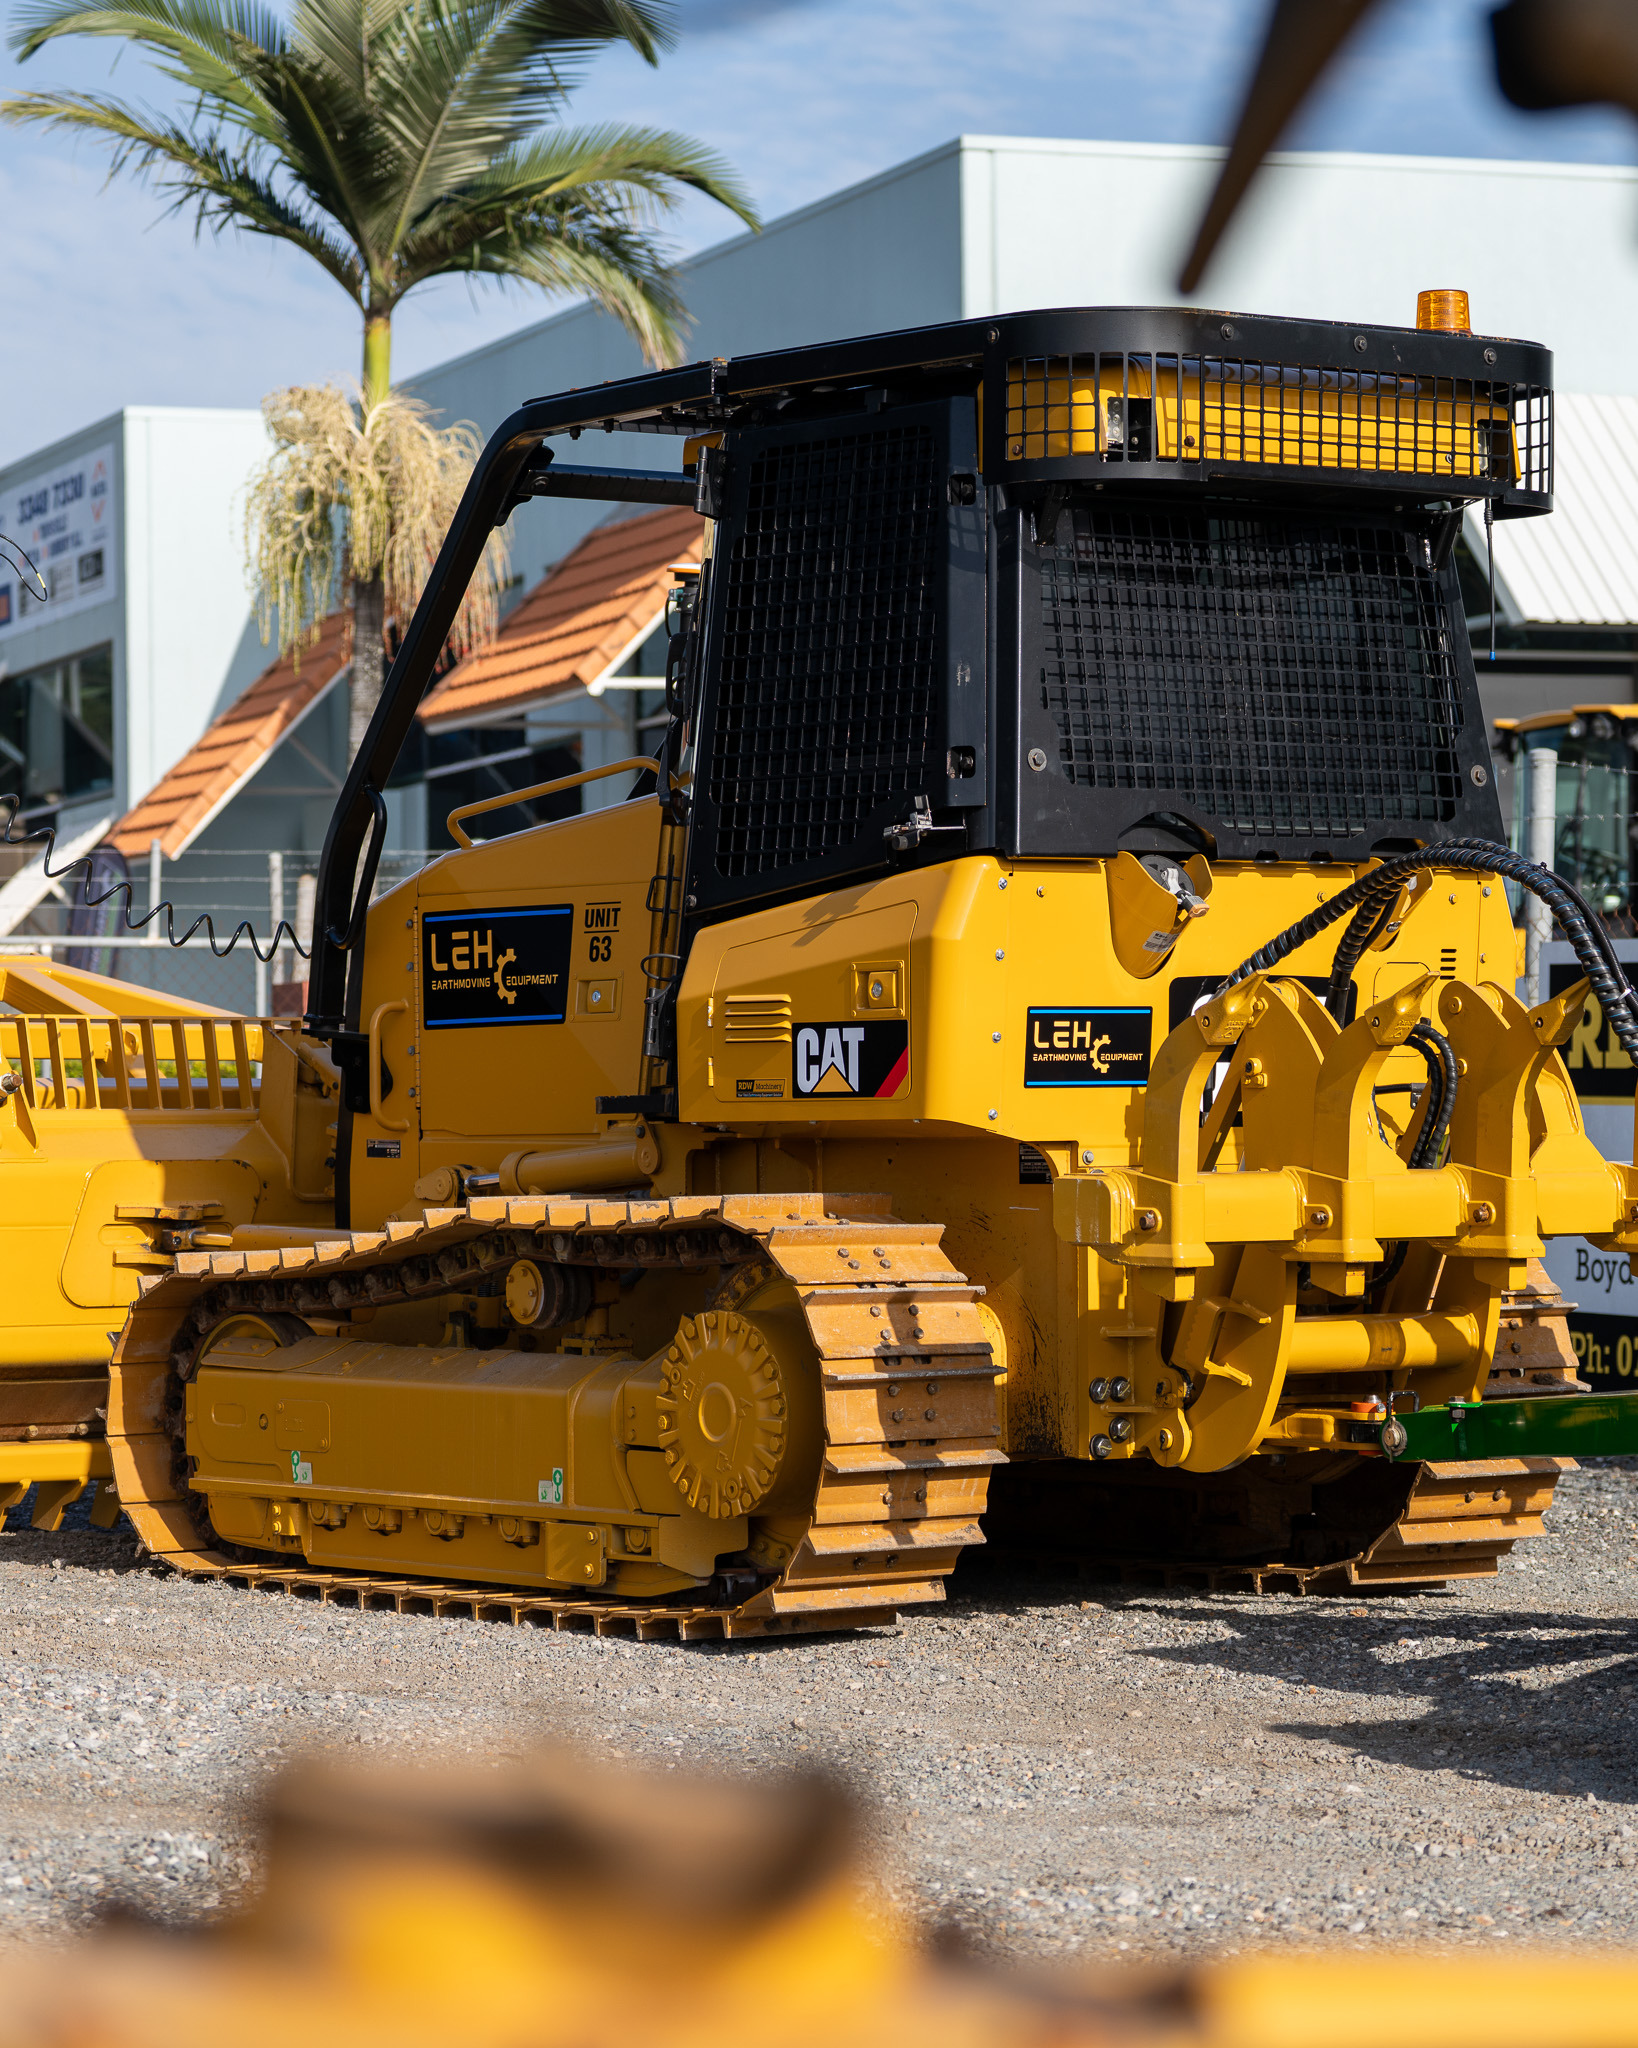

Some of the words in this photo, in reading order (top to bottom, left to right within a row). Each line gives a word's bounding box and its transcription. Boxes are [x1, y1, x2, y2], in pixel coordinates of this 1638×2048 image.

[584, 907, 621, 929] UNIT
[431, 929, 493, 972] LEH
[589, 935, 612, 963] 63
[431, 977, 491, 991] EARTHMOVING
[506, 974, 559, 986] EQUIPMENT
[1034, 1021, 1091, 1049] LEH
[797, 1027, 865, 1093] CAT
[1032, 1053, 1087, 1062] EARTHMOVING
[1100, 1053, 1143, 1061] EQUIPMENT
[738, 1081, 753, 1090] RDW
[755, 1083, 782, 1091] Machinery
[1571, 1331, 1611, 1374] Ph:
